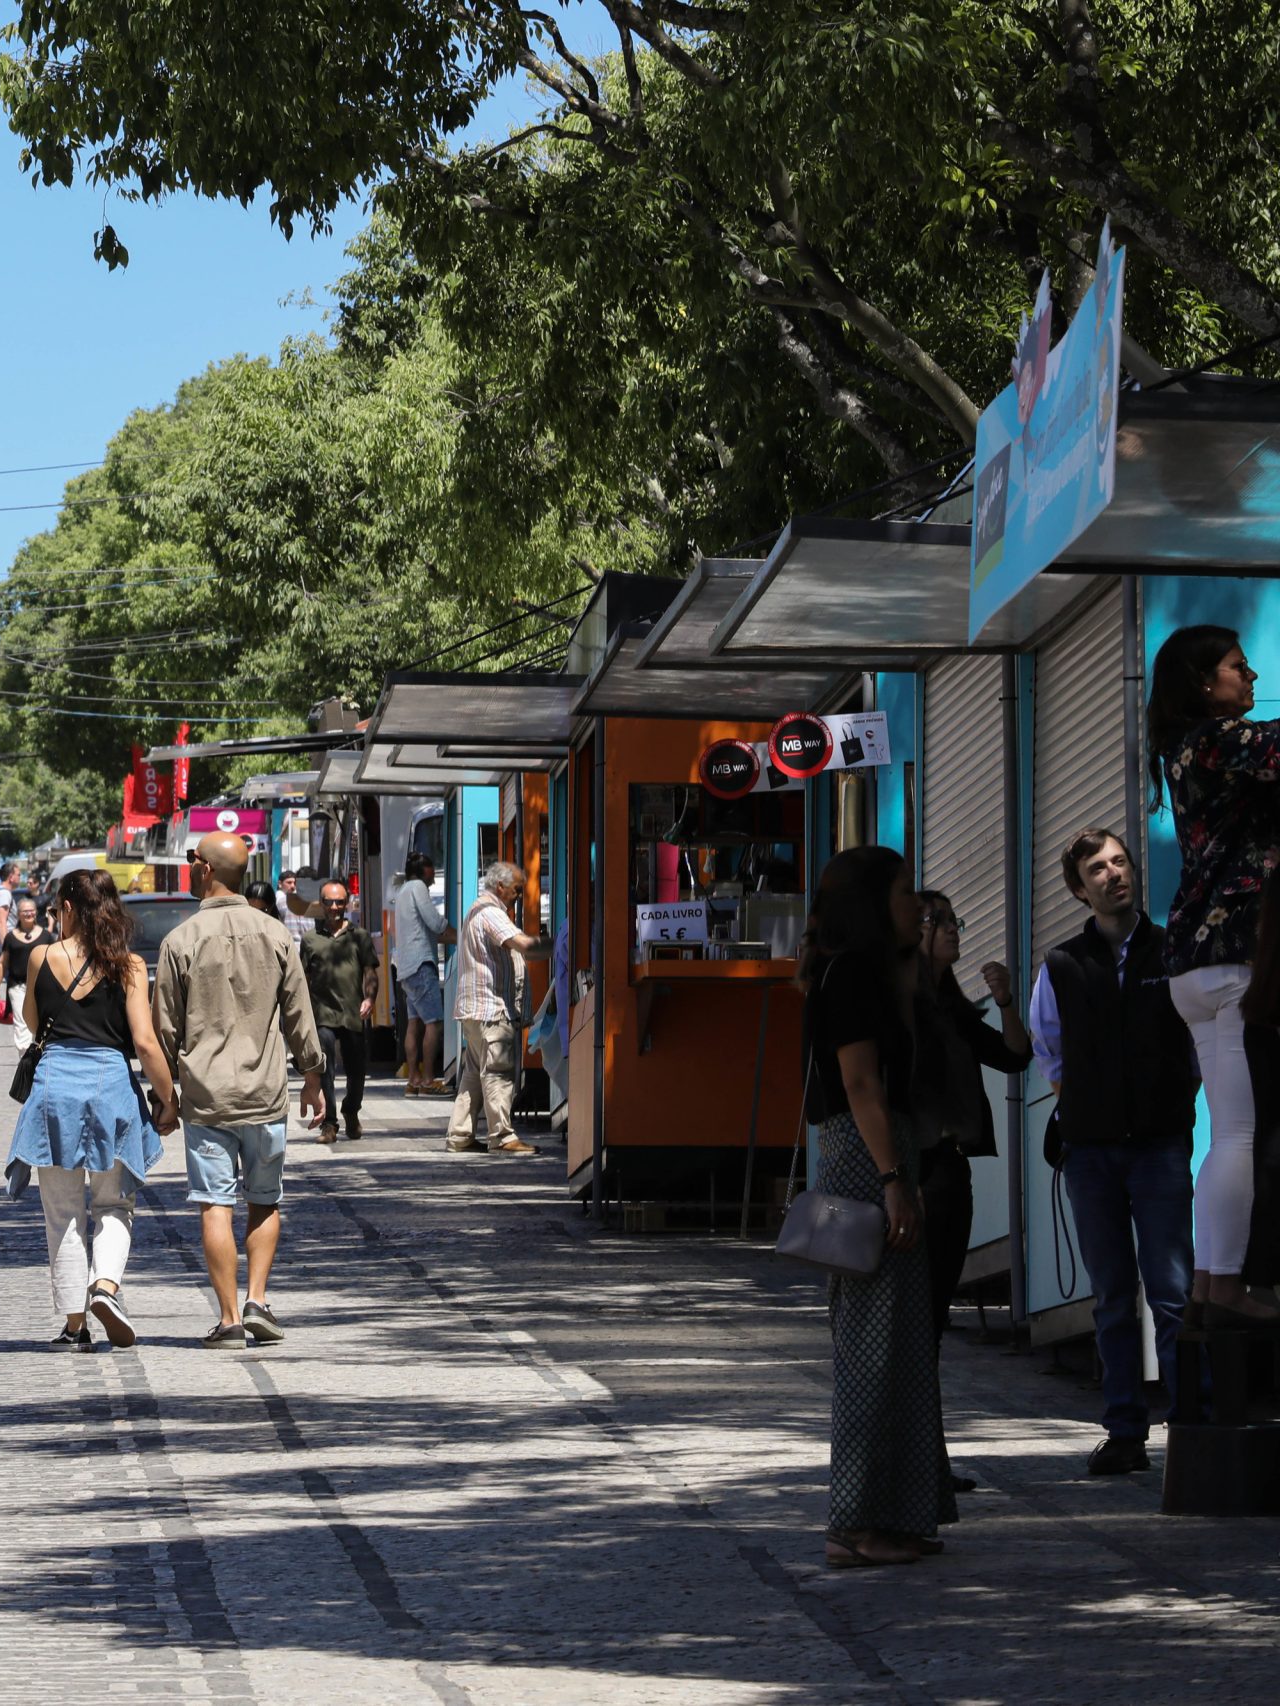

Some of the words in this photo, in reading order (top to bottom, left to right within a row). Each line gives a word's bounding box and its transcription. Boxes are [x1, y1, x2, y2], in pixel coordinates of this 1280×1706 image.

[782, 739, 802, 752] MB
[803, 740, 821, 748] WAY
[712, 763, 731, 775] MB
[732, 764, 749, 772] WAY
[641, 911, 670, 920] CADA
[672, 909, 703, 918] LIVRO
[660, 928, 670, 940] 5
[676, 927, 687, 940] €
